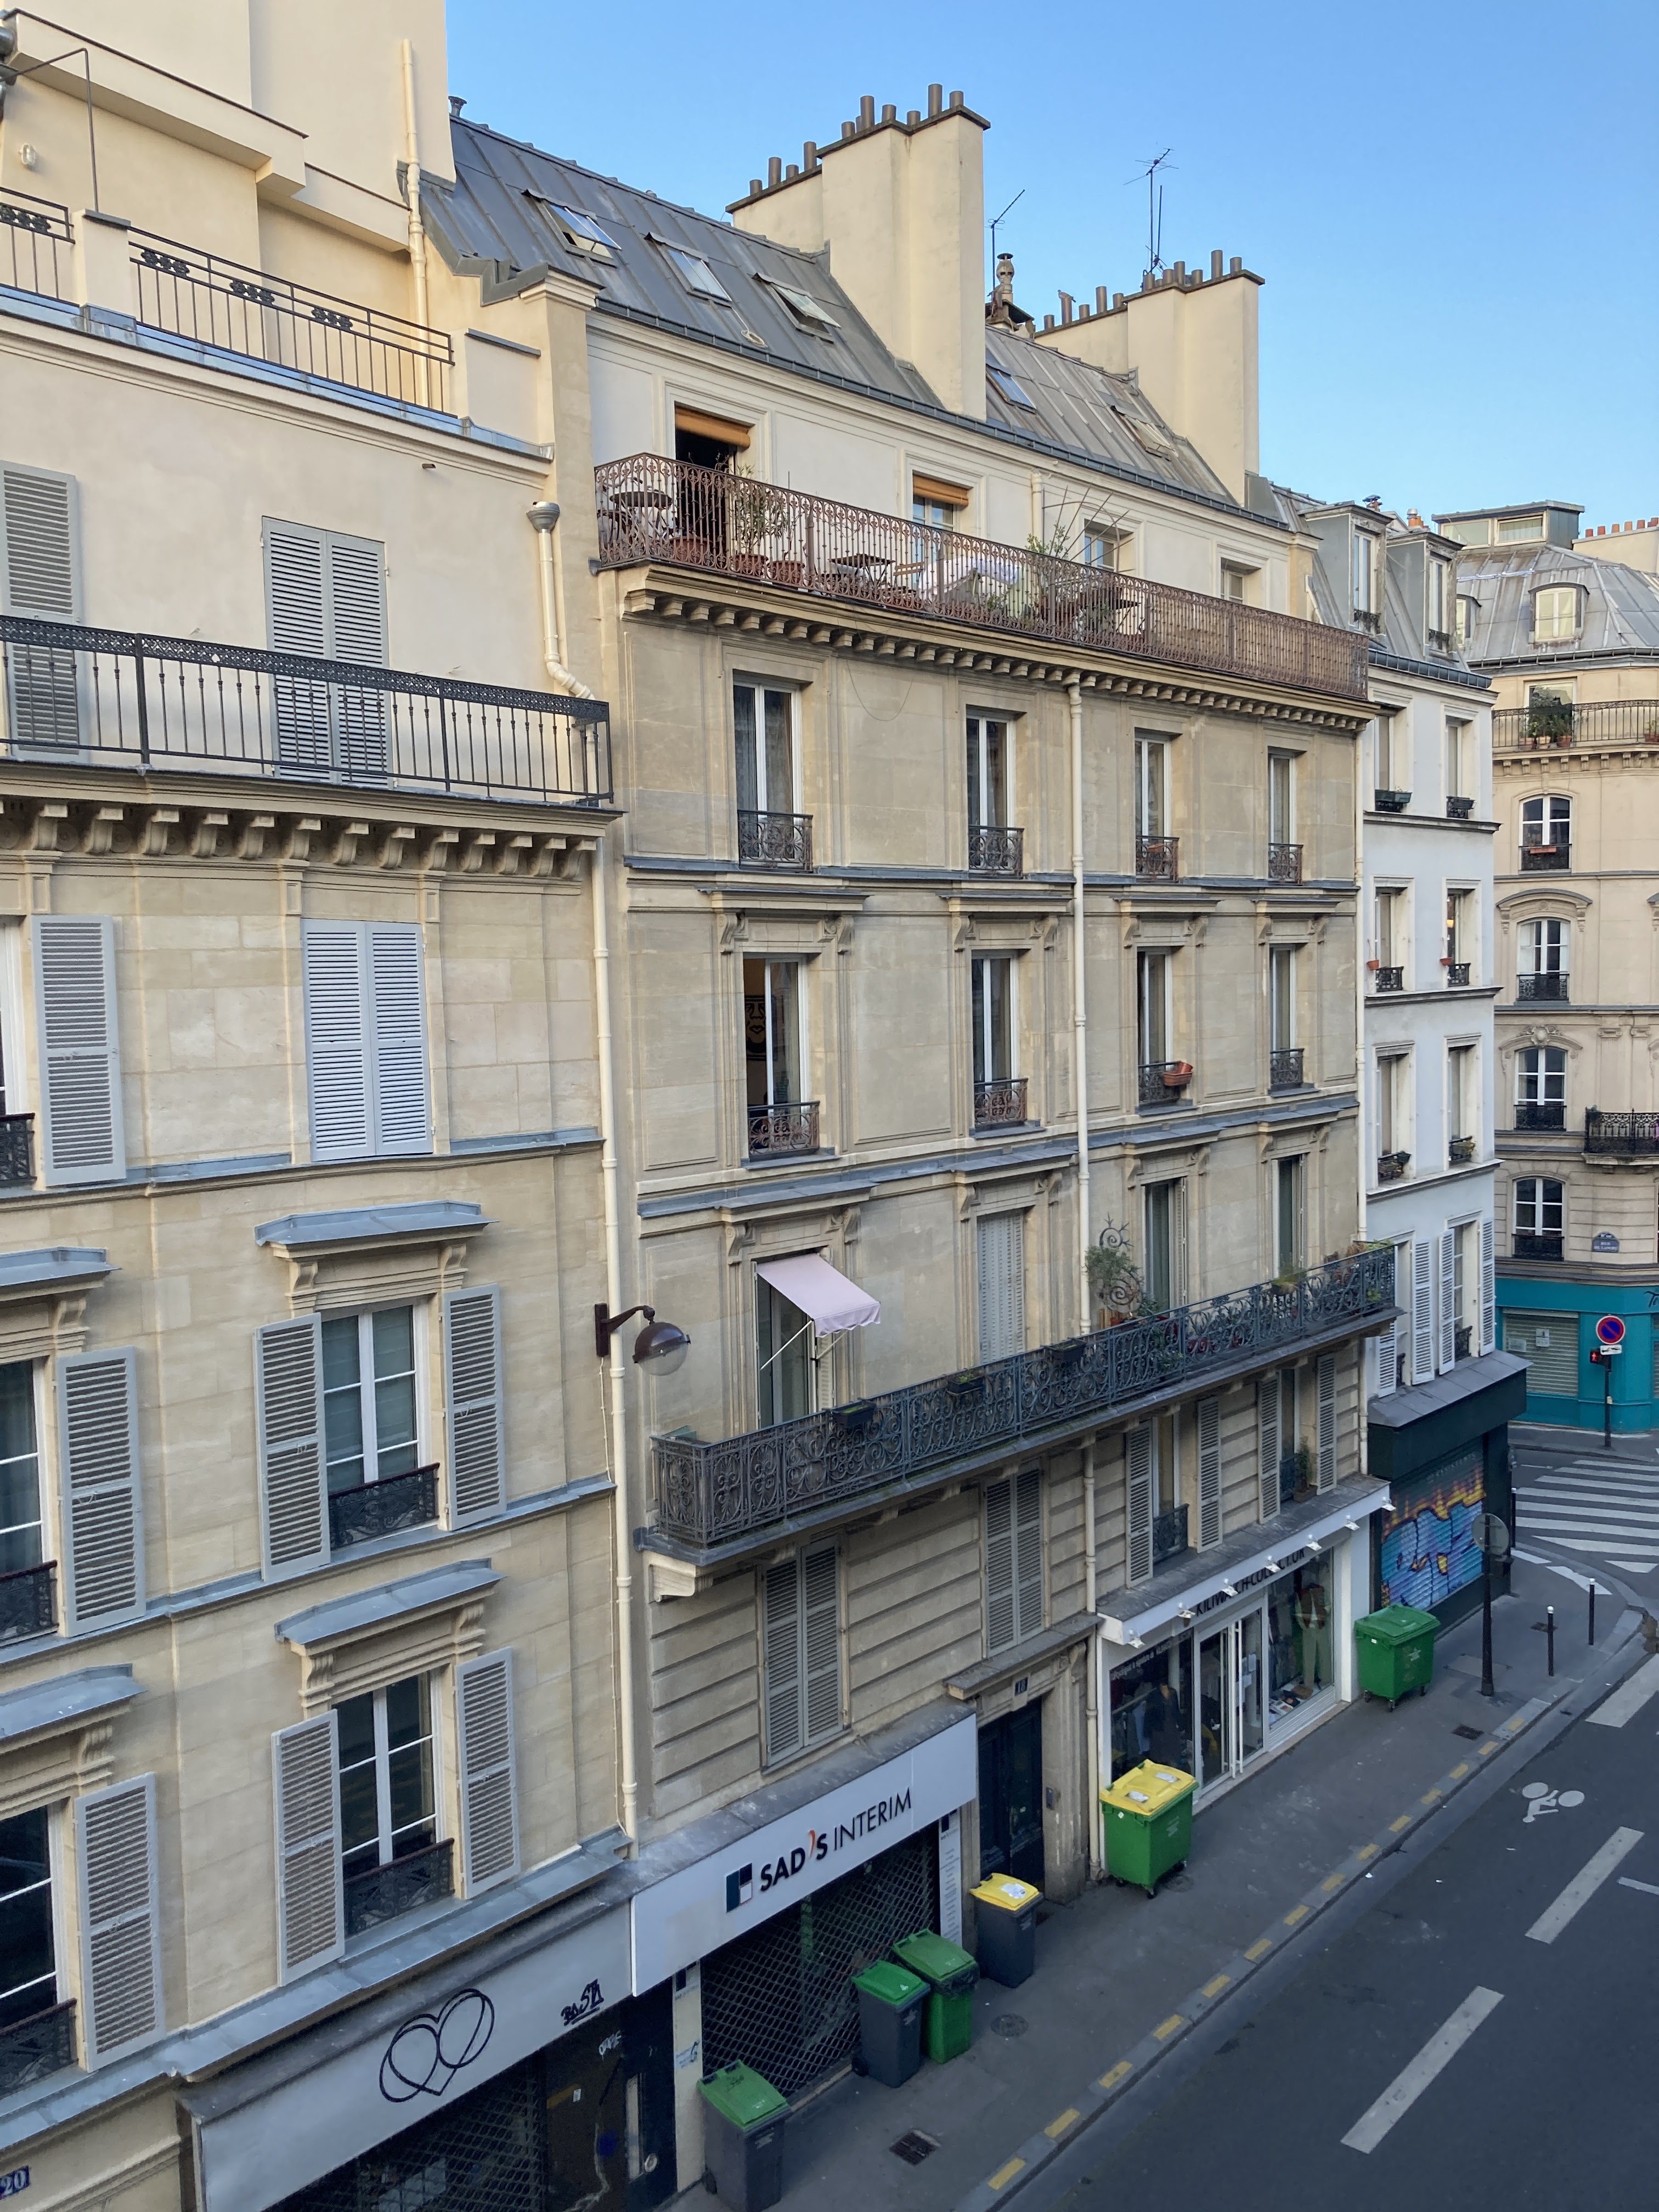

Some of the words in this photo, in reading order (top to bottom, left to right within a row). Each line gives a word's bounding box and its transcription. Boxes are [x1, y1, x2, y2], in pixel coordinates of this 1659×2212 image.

[1017, 1679, 1025, 1694] 18
[760, 1830, 828, 1892] SAD'S
[833, 1787, 911, 1852] INTERIM
[0, 2170, 26, 2196] 20
